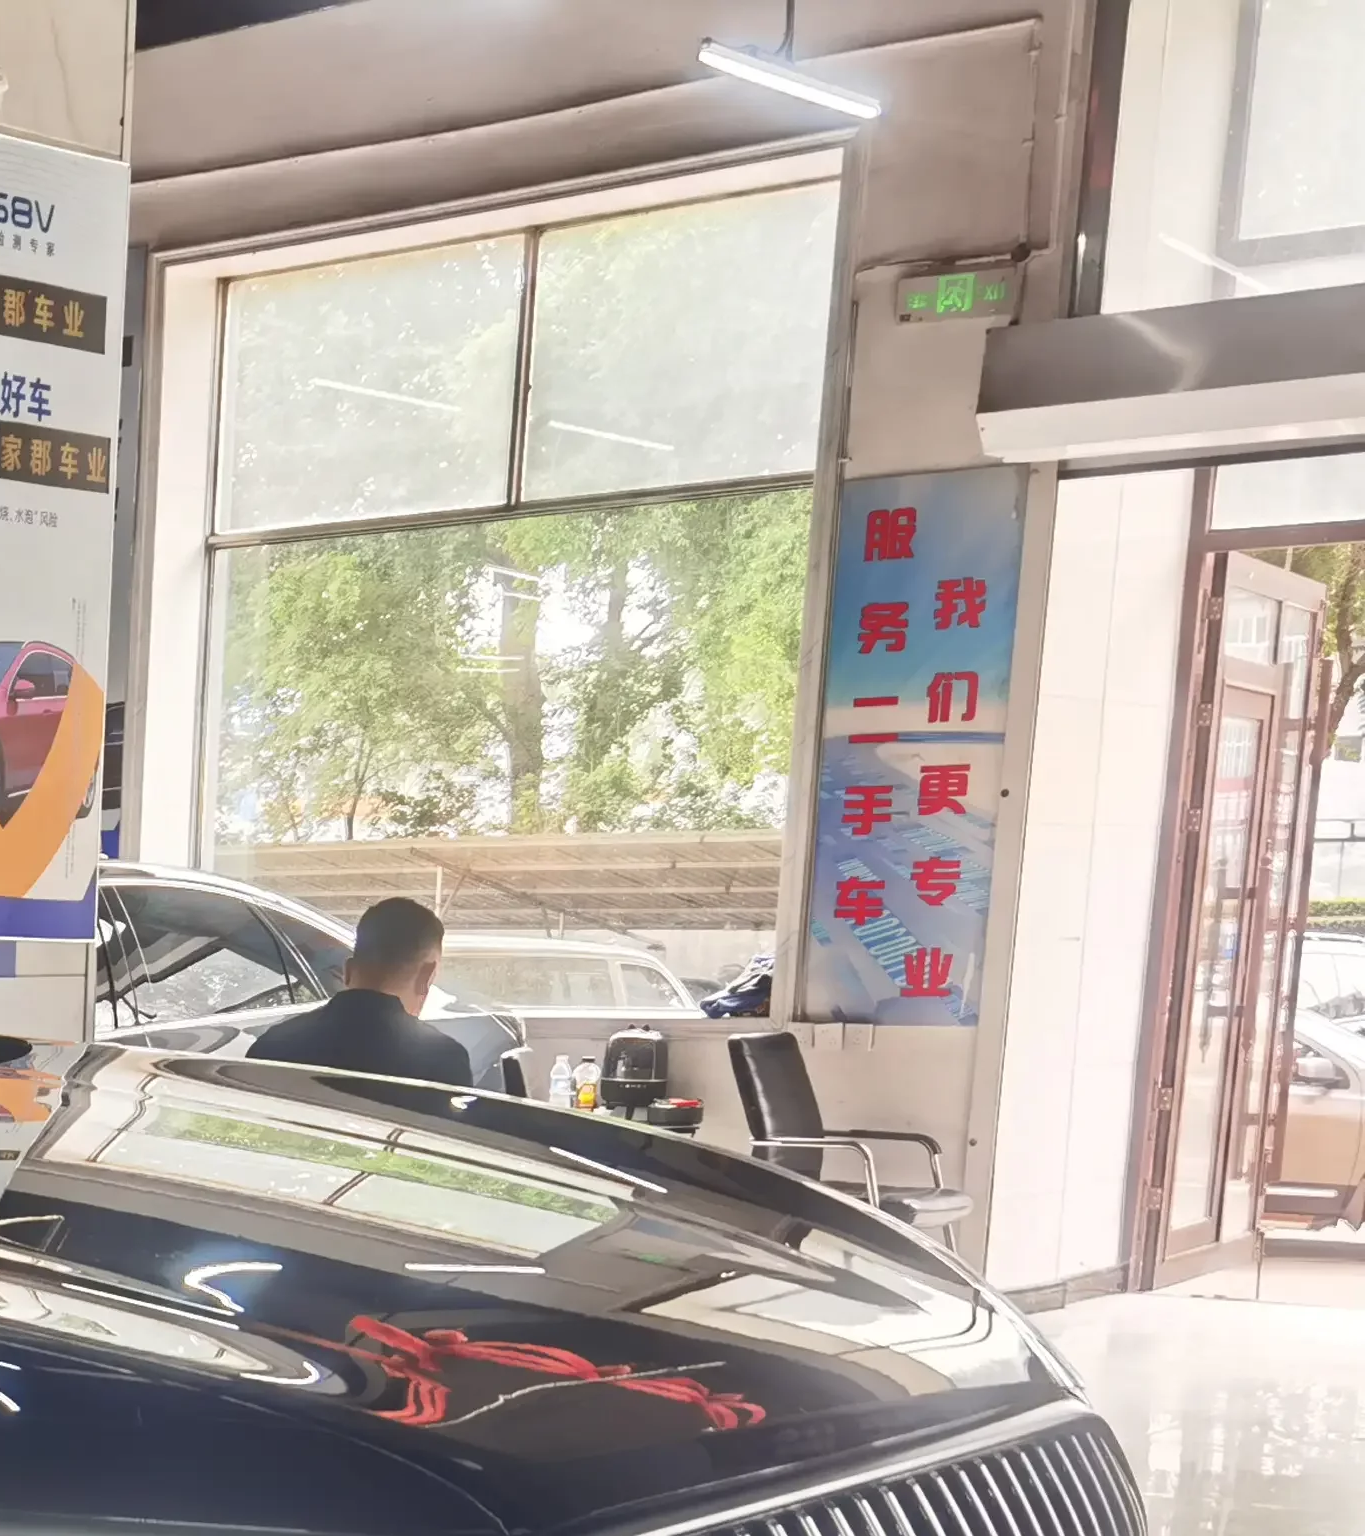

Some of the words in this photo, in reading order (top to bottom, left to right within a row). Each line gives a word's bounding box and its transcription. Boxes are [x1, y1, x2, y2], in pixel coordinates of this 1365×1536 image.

[833, 506, 918, 927] 服务二手车
[898, 576, 988, 1000] 我们更专业
